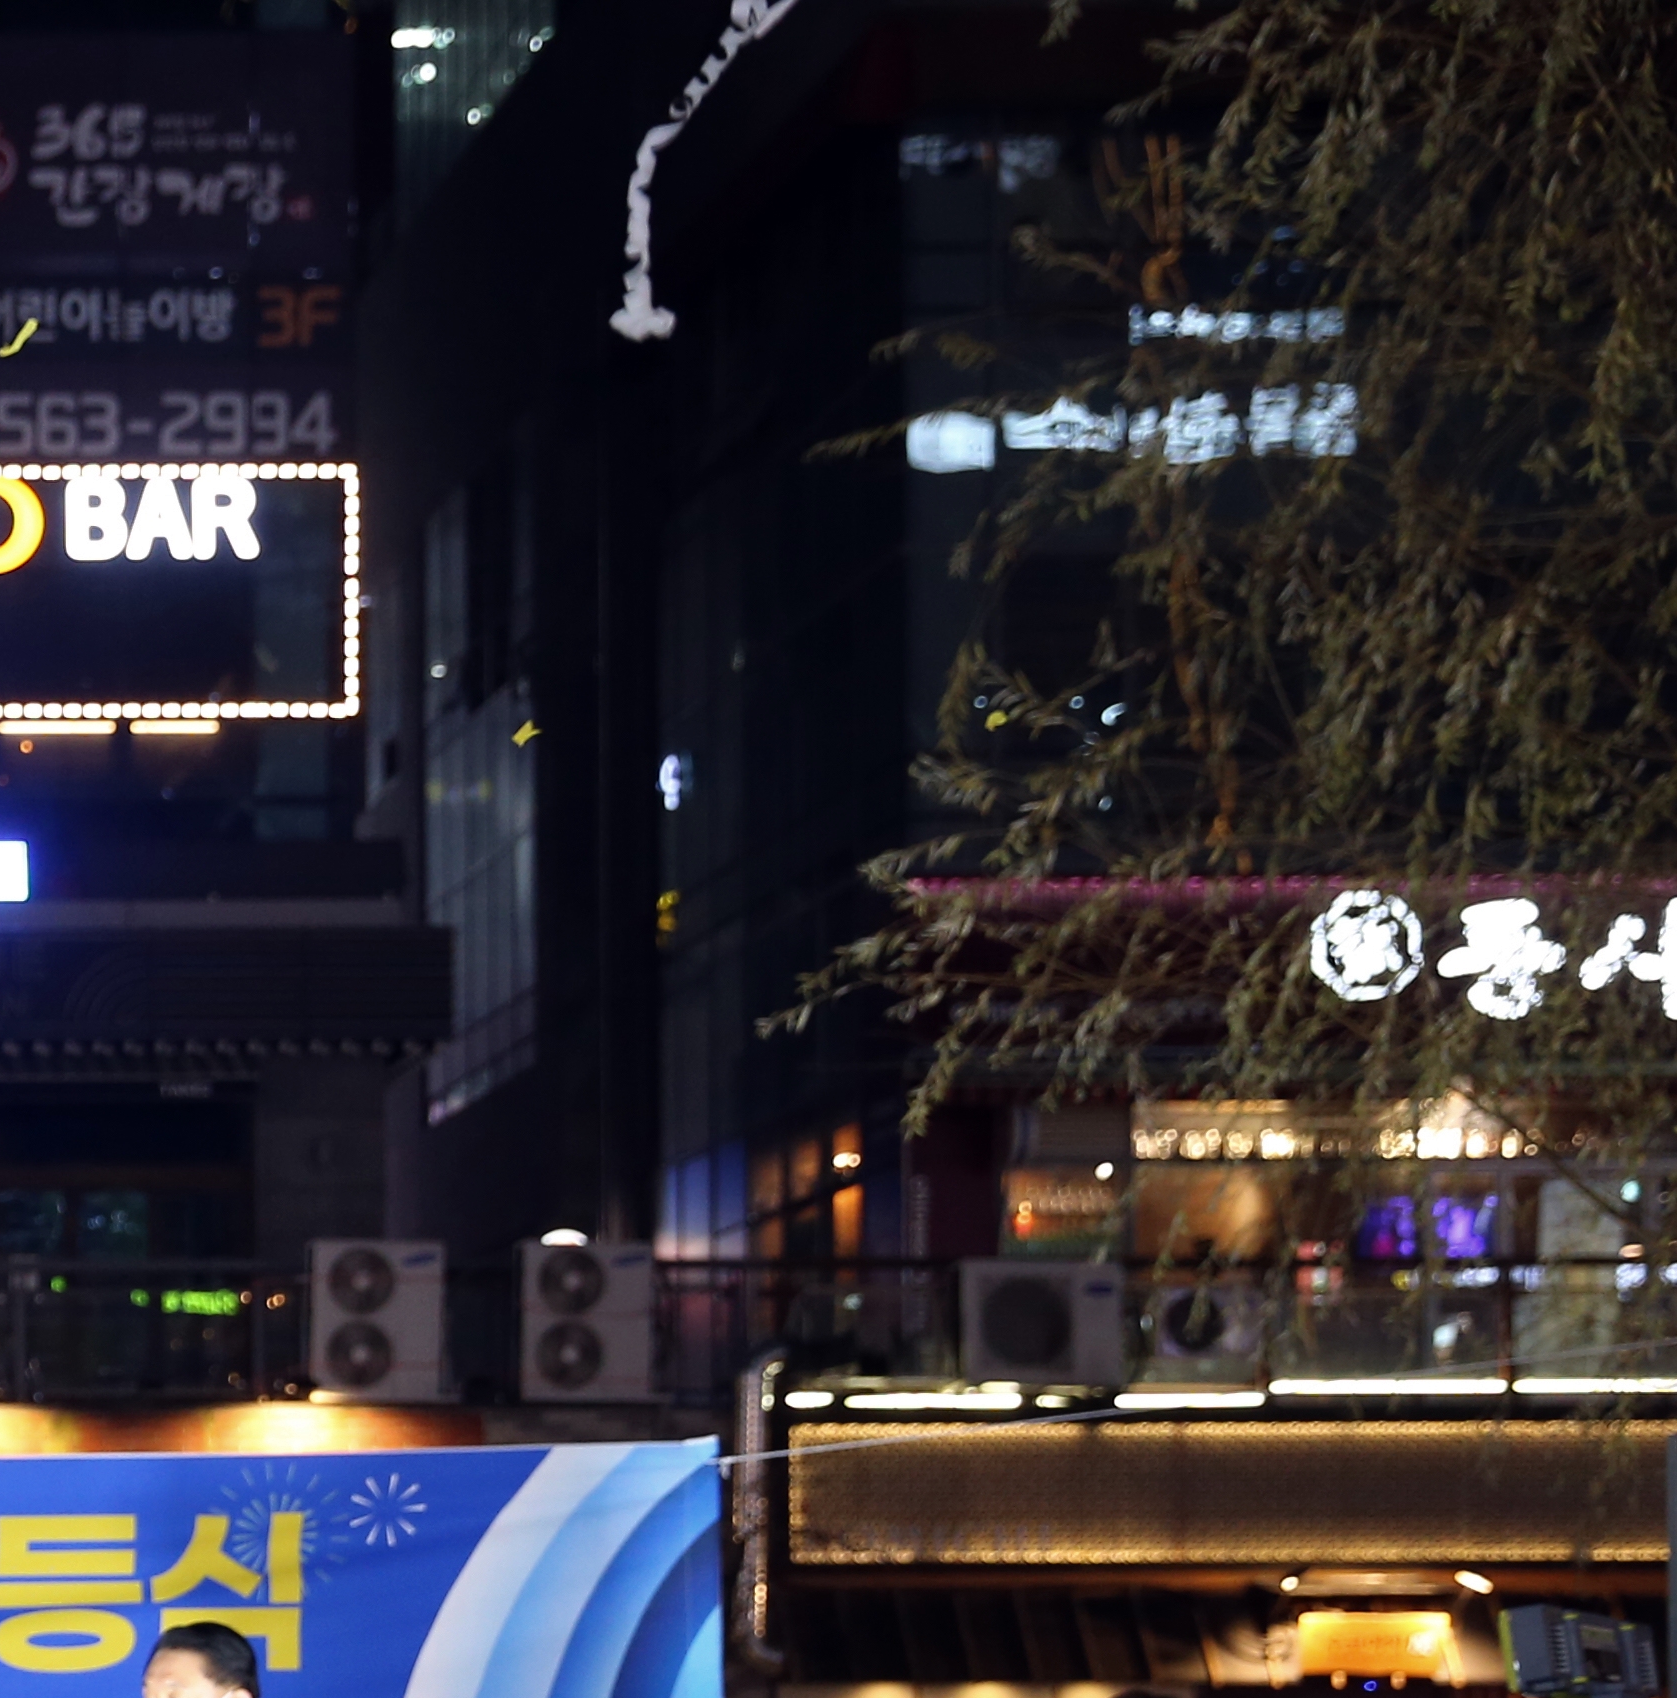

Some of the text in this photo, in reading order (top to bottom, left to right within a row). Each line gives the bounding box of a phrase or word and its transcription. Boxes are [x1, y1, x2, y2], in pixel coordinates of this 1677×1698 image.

[30, 101, 147, 161] 365
[27, 161, 287, 227] 간장게장
[256, 284, 343, 349] 3F
[64, 477, 261, 562] BAR
